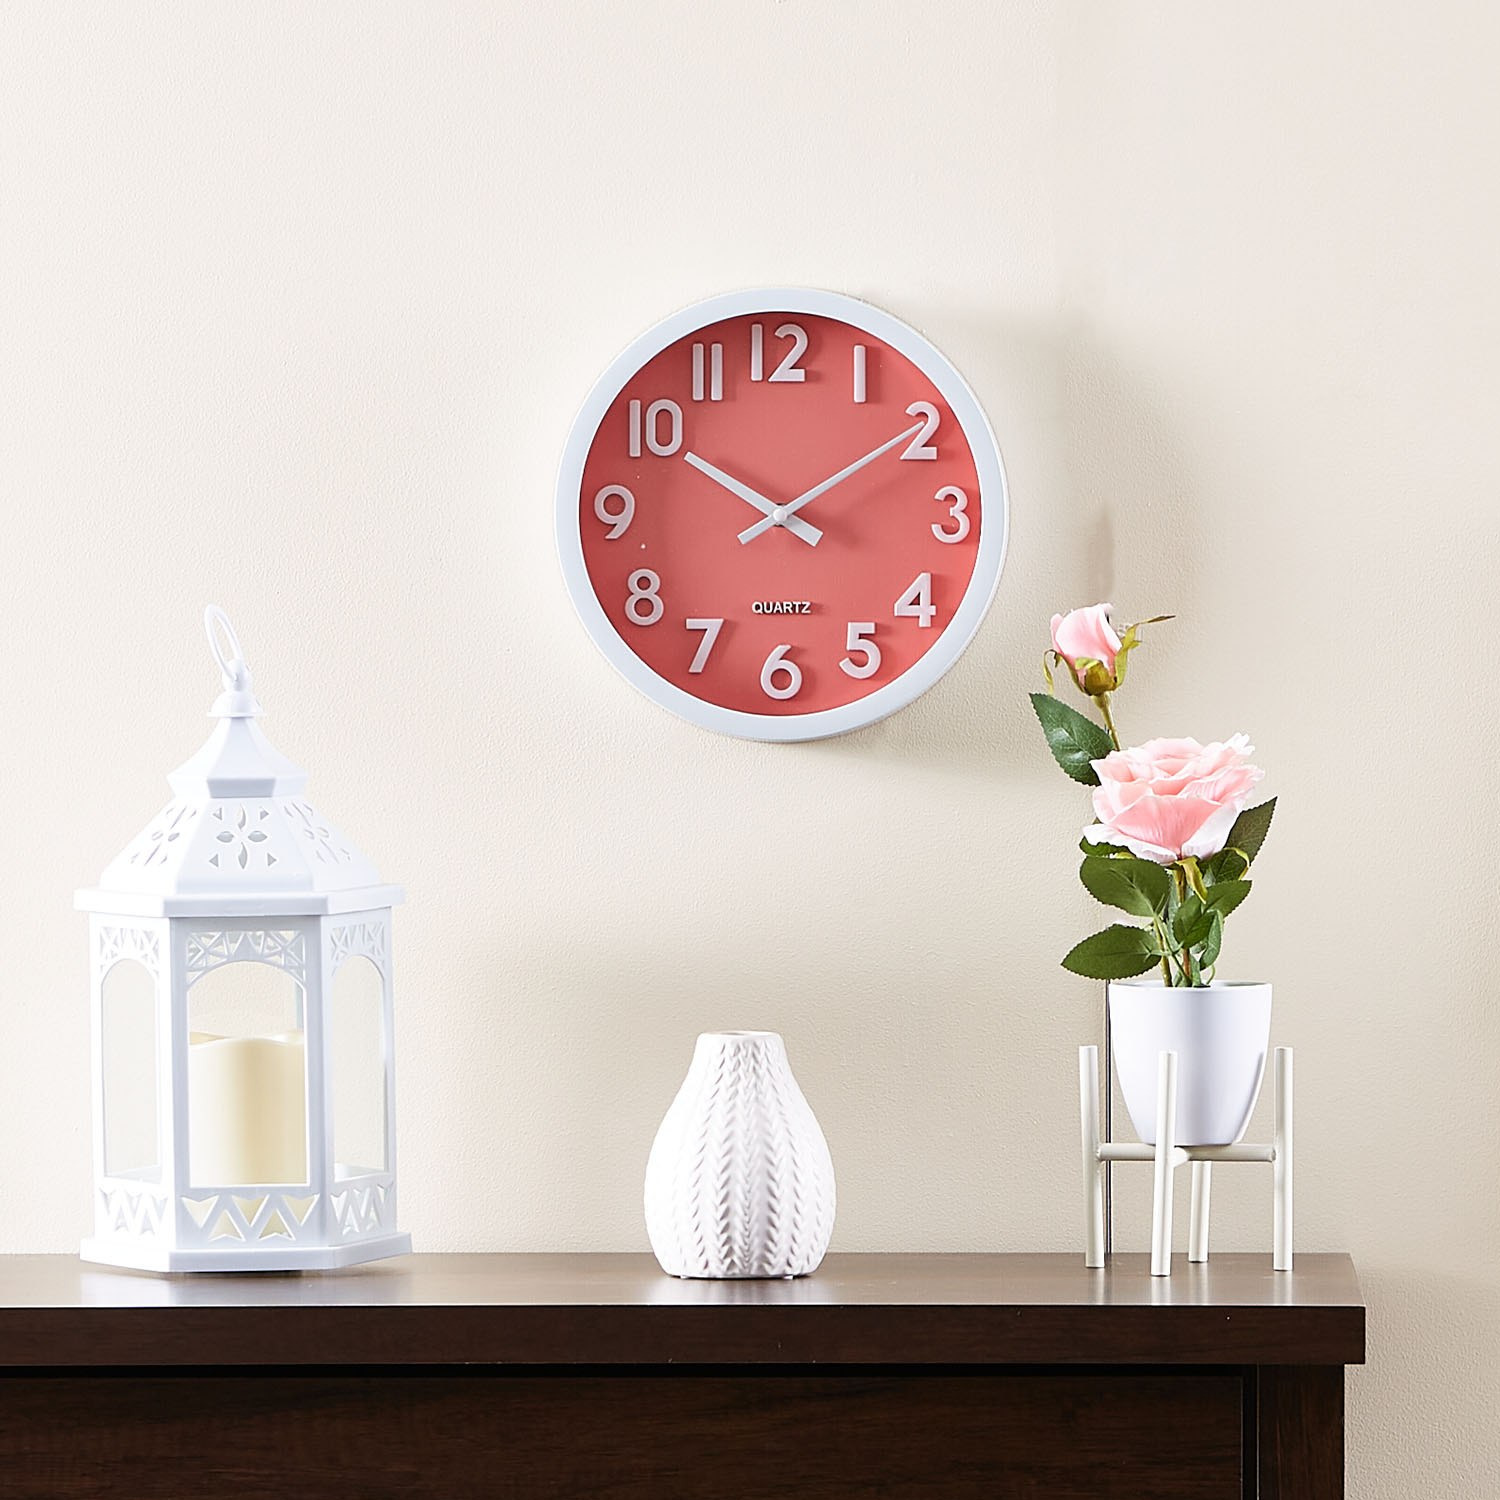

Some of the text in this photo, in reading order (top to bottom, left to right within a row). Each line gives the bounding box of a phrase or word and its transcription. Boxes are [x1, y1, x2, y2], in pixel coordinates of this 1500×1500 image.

[692, 343, 723, 401] 11
[751, 323, 809, 382] 12
[853, 345, 867, 403] 1
[629, 399, 683, 458] 10
[900, 401, 941, 460] 2
[594, 484, 635, 540] 9
[931, 485, 971, 544] 3
[624, 568, 664, 626] 8
[751, 601, 811, 614] QUARTZ
[894, 572, 937, 628] 4
[686, 618, 725, 674] 7
[760, 644, 803, 700] 6
[839, 621, 881, 680] 5
